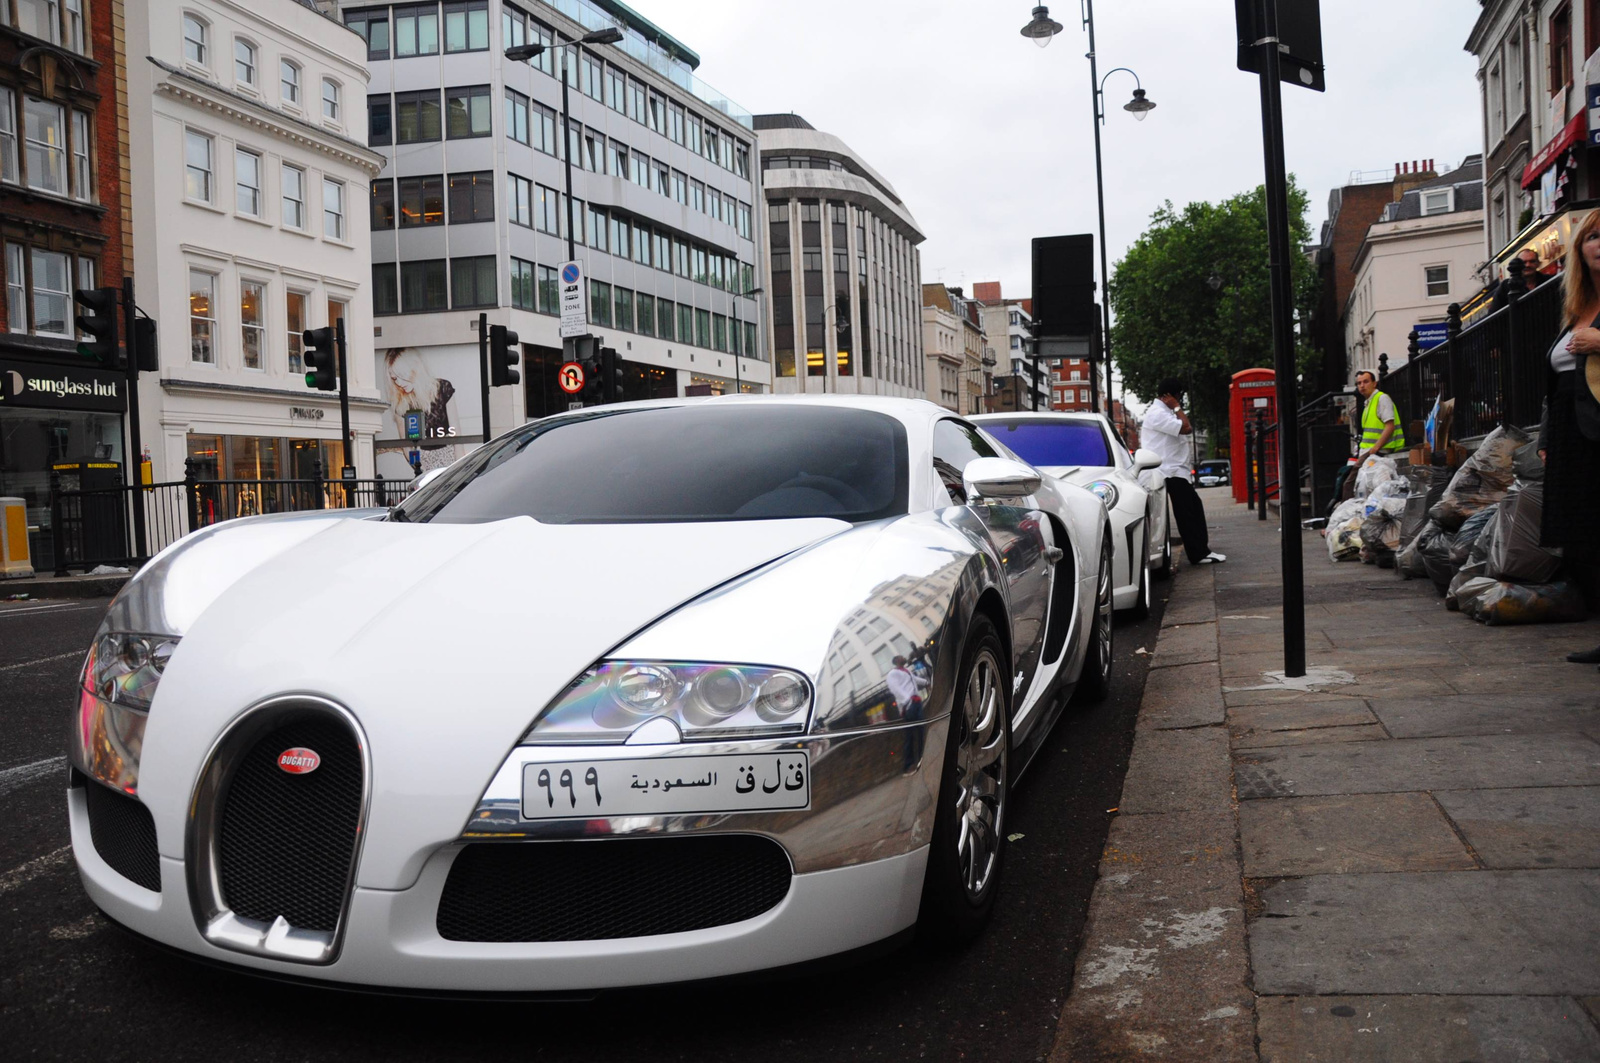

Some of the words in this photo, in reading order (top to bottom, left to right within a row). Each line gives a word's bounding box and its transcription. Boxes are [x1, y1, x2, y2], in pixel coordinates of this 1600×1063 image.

[565, 303, 580, 311] ZONE
[27, 376, 92, 398] sunglass
[93, 379, 118, 397] hut
[409, 416, 417, 429] P
[281, 755, 315, 767] BUGATTI
[630, 772, 717, 793] السعودية
